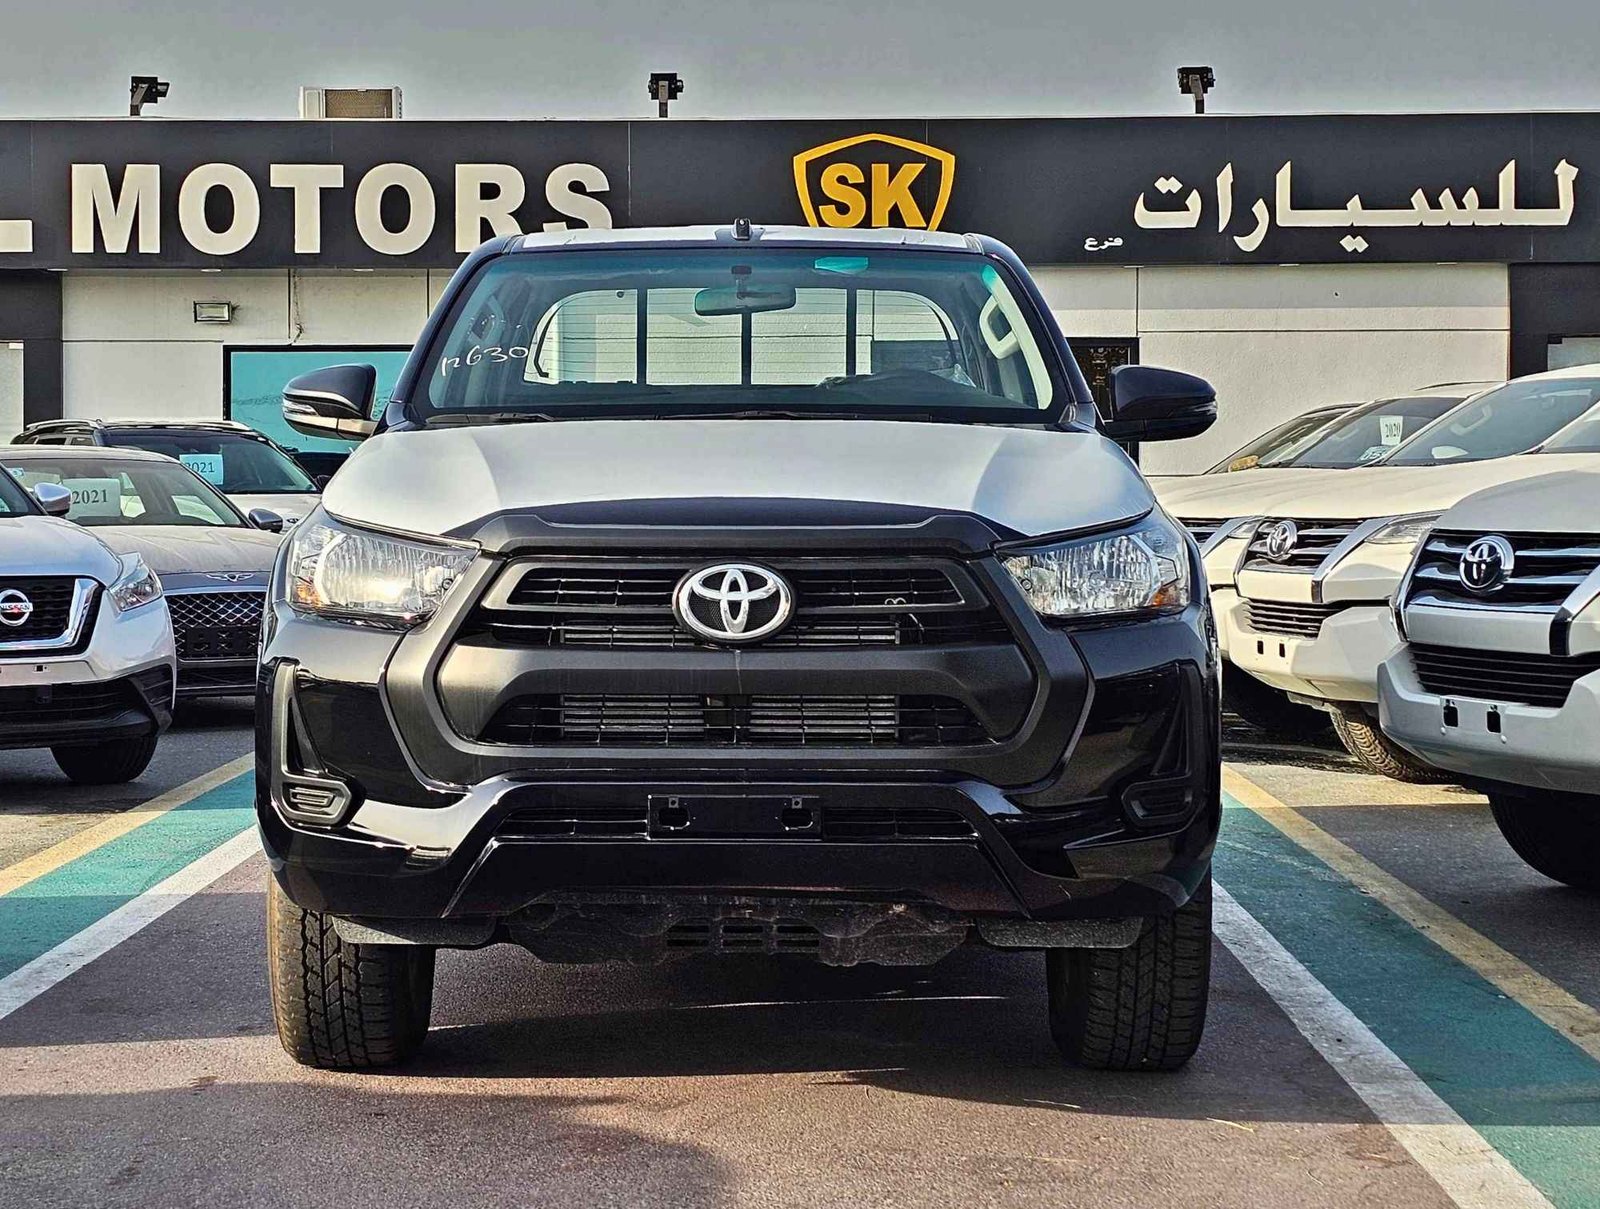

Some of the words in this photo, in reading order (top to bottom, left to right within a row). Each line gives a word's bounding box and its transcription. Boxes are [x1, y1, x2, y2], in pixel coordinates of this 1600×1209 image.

[71, 162, 613, 255] MOTORS
[818, 162, 927, 228] SK
[1134, 158, 1579, 252] للسيارات
[1385, 422, 1401, 437] 2020
[72, 489, 108, 504] 2021
